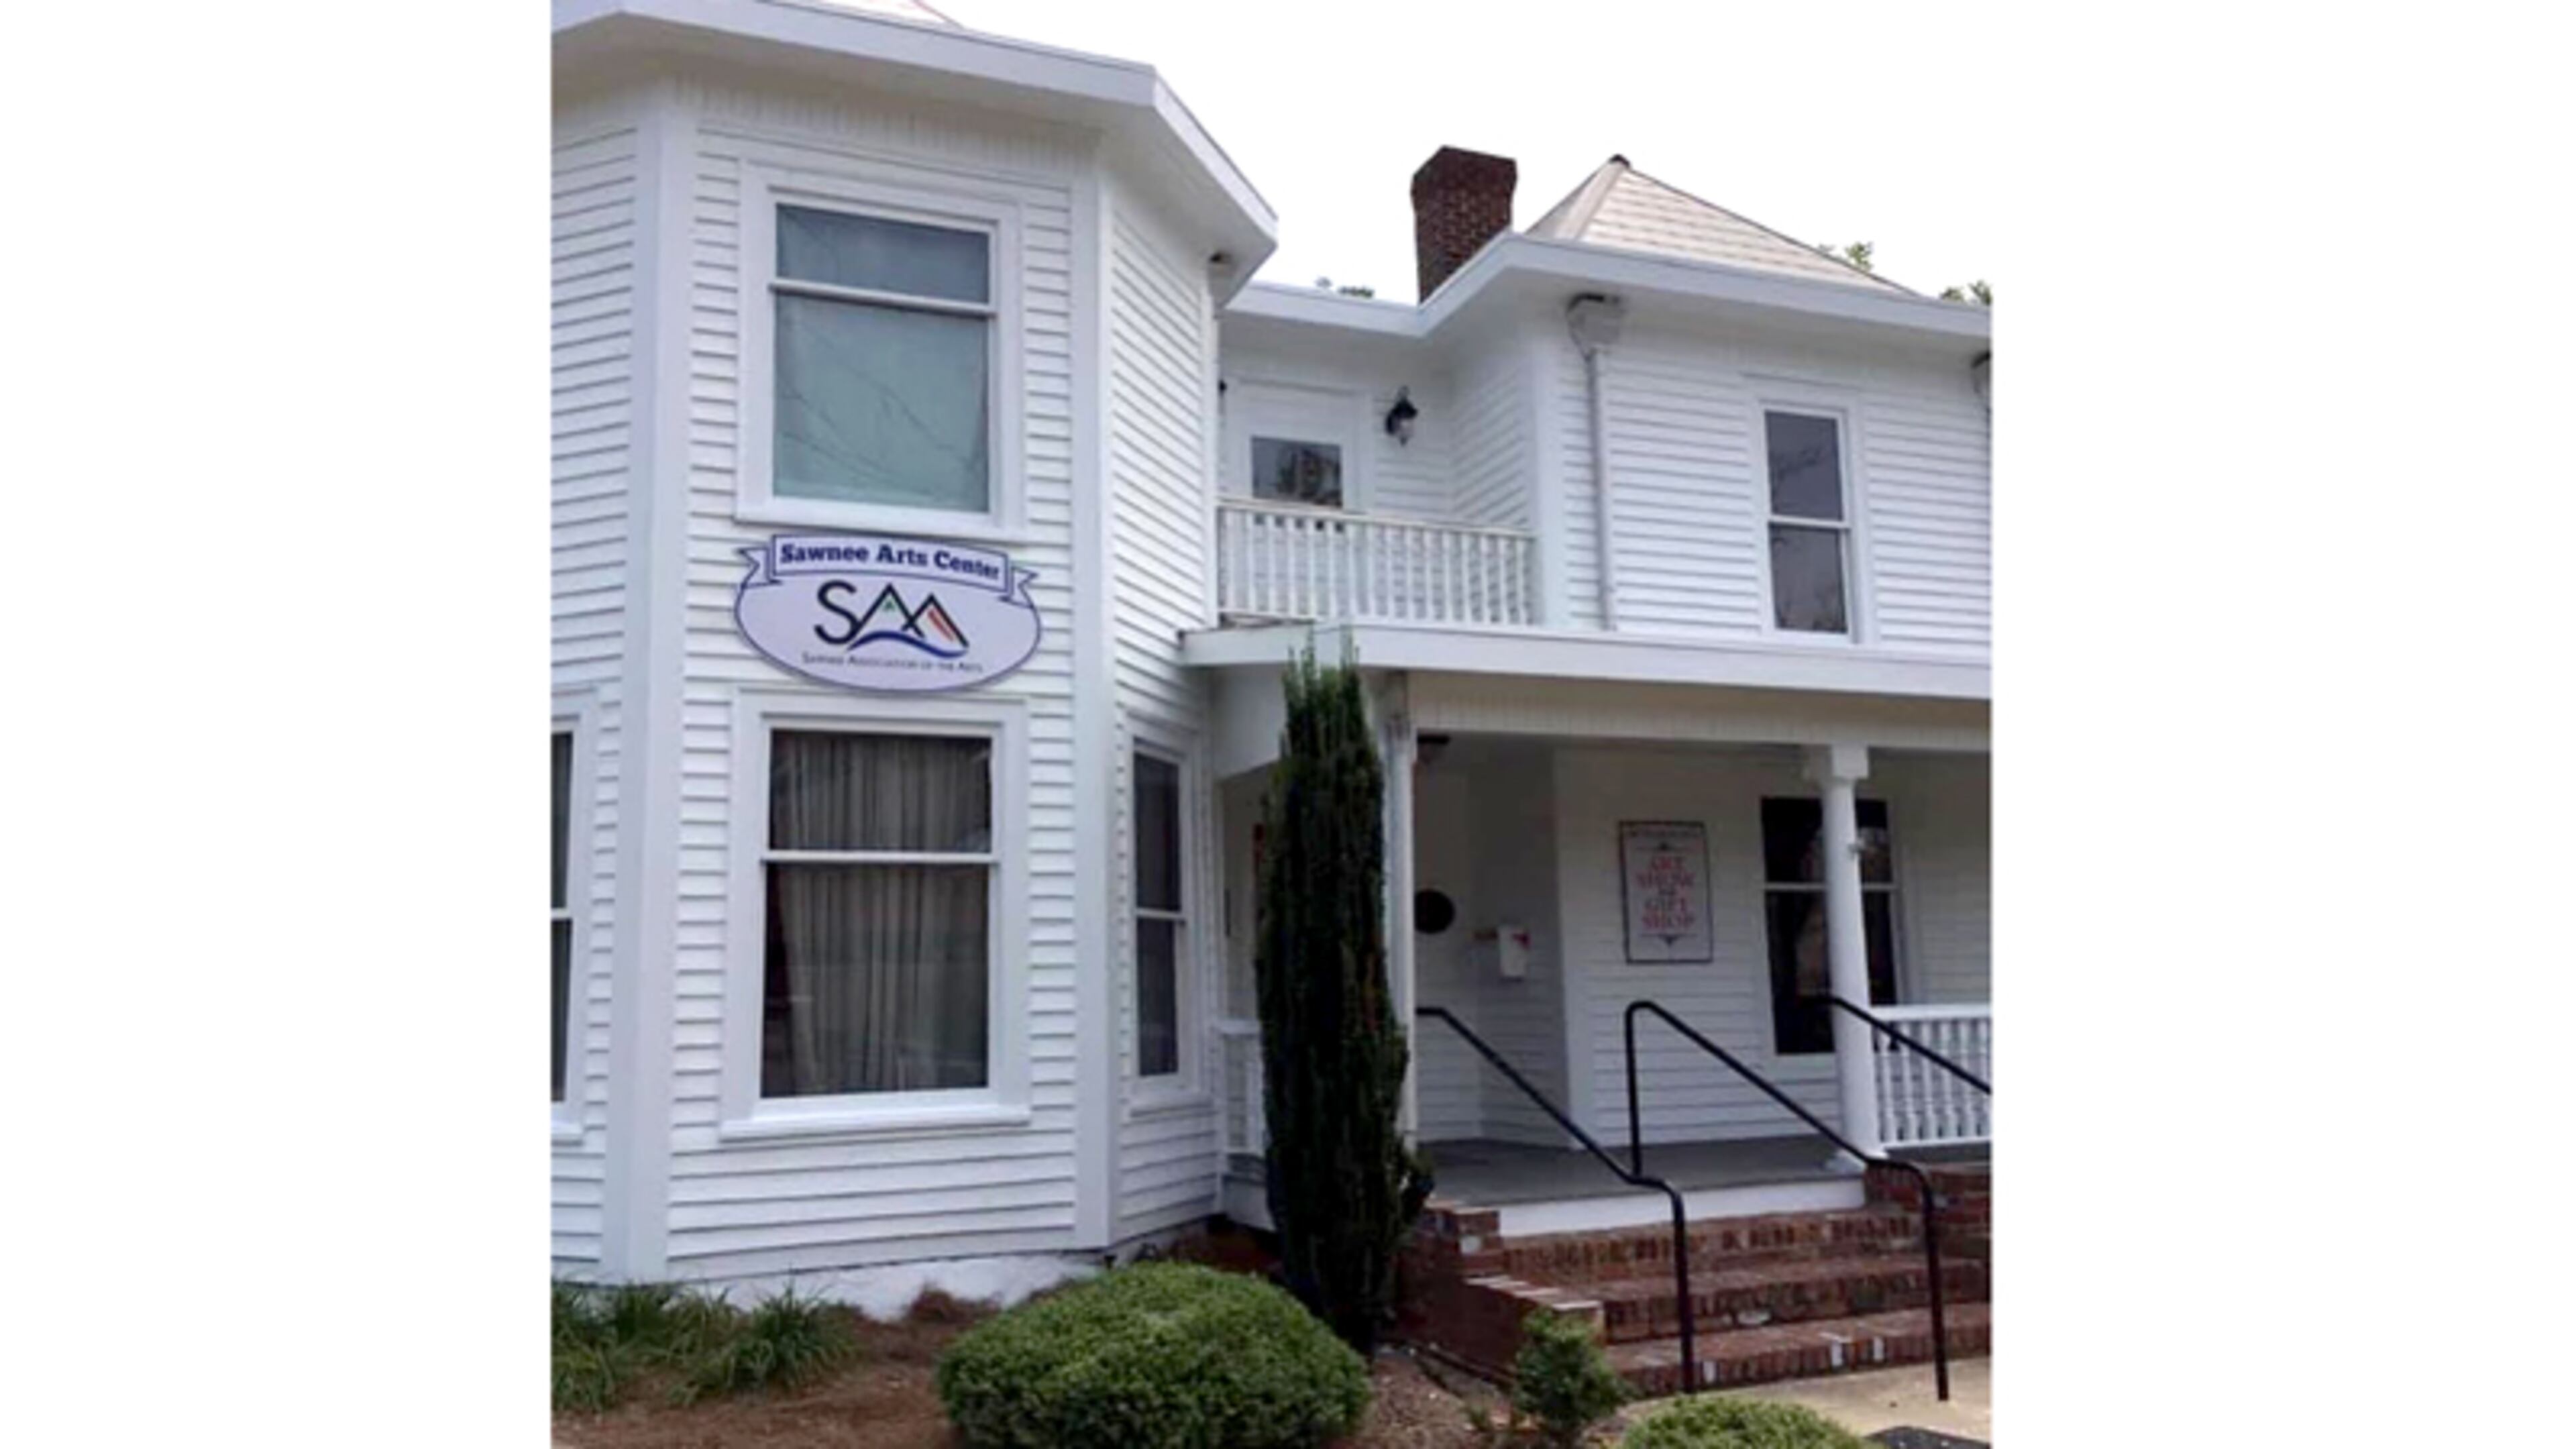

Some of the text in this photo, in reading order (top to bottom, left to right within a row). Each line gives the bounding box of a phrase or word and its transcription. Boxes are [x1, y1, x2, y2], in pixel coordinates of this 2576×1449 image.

[780, 544, 998, 580] Sawnee Arts Center
